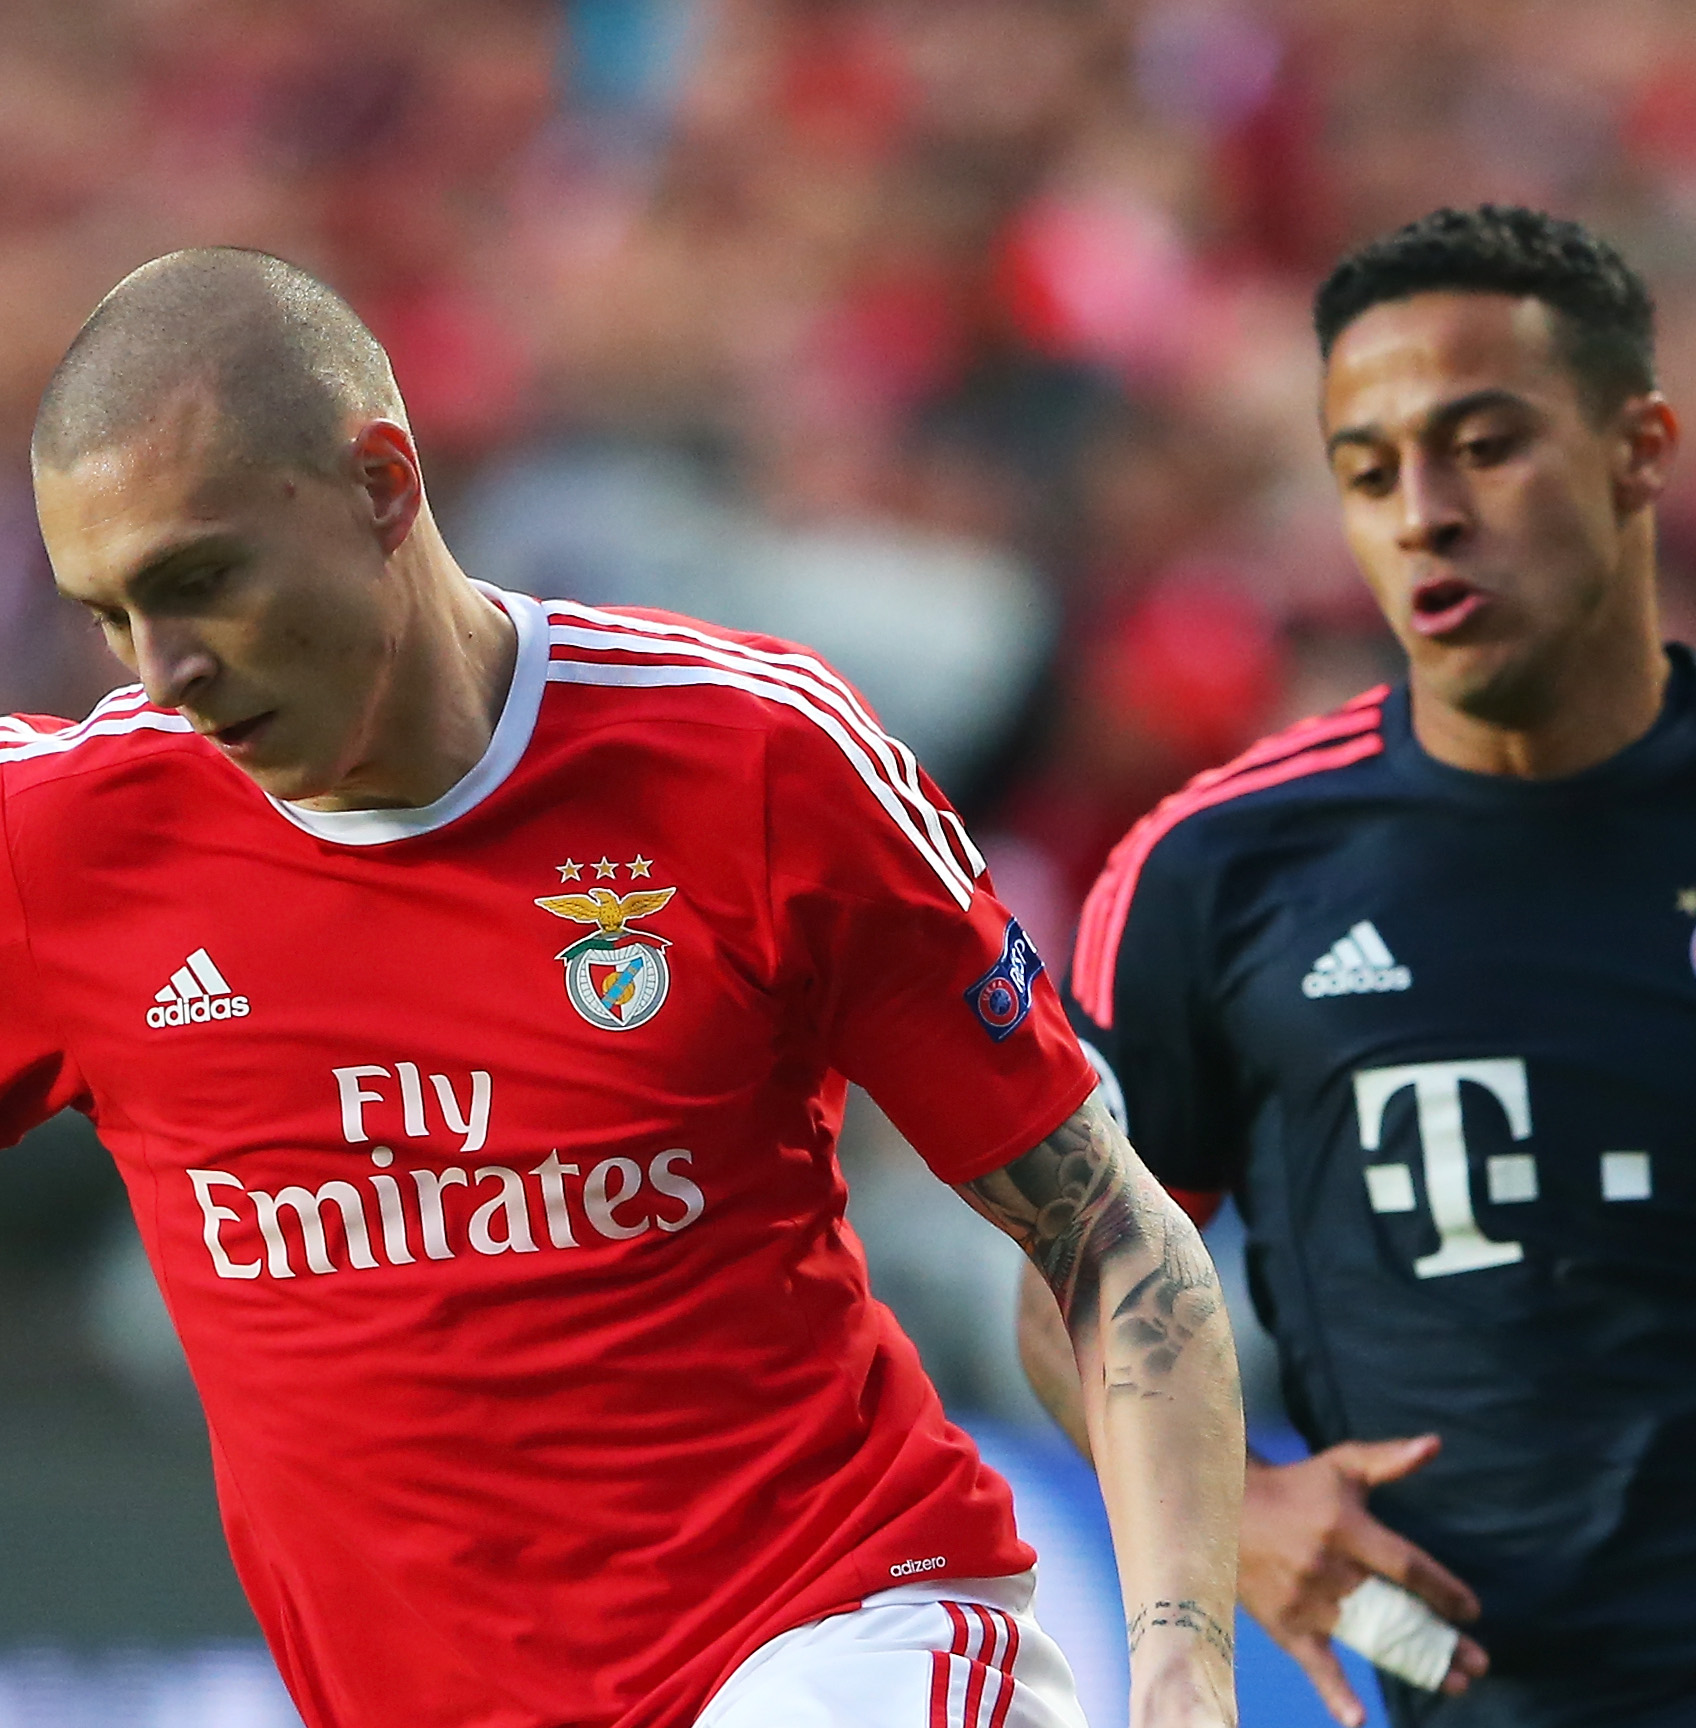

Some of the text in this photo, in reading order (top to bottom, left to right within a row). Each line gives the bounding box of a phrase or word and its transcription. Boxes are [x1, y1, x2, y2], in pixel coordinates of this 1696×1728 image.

[146, 994, 252, 1029] adidas
[331, 1062, 492, 1152] Fly
[185, 1145, 705, 1280] Emirates
[889, 1555, 946, 1577] adizero
